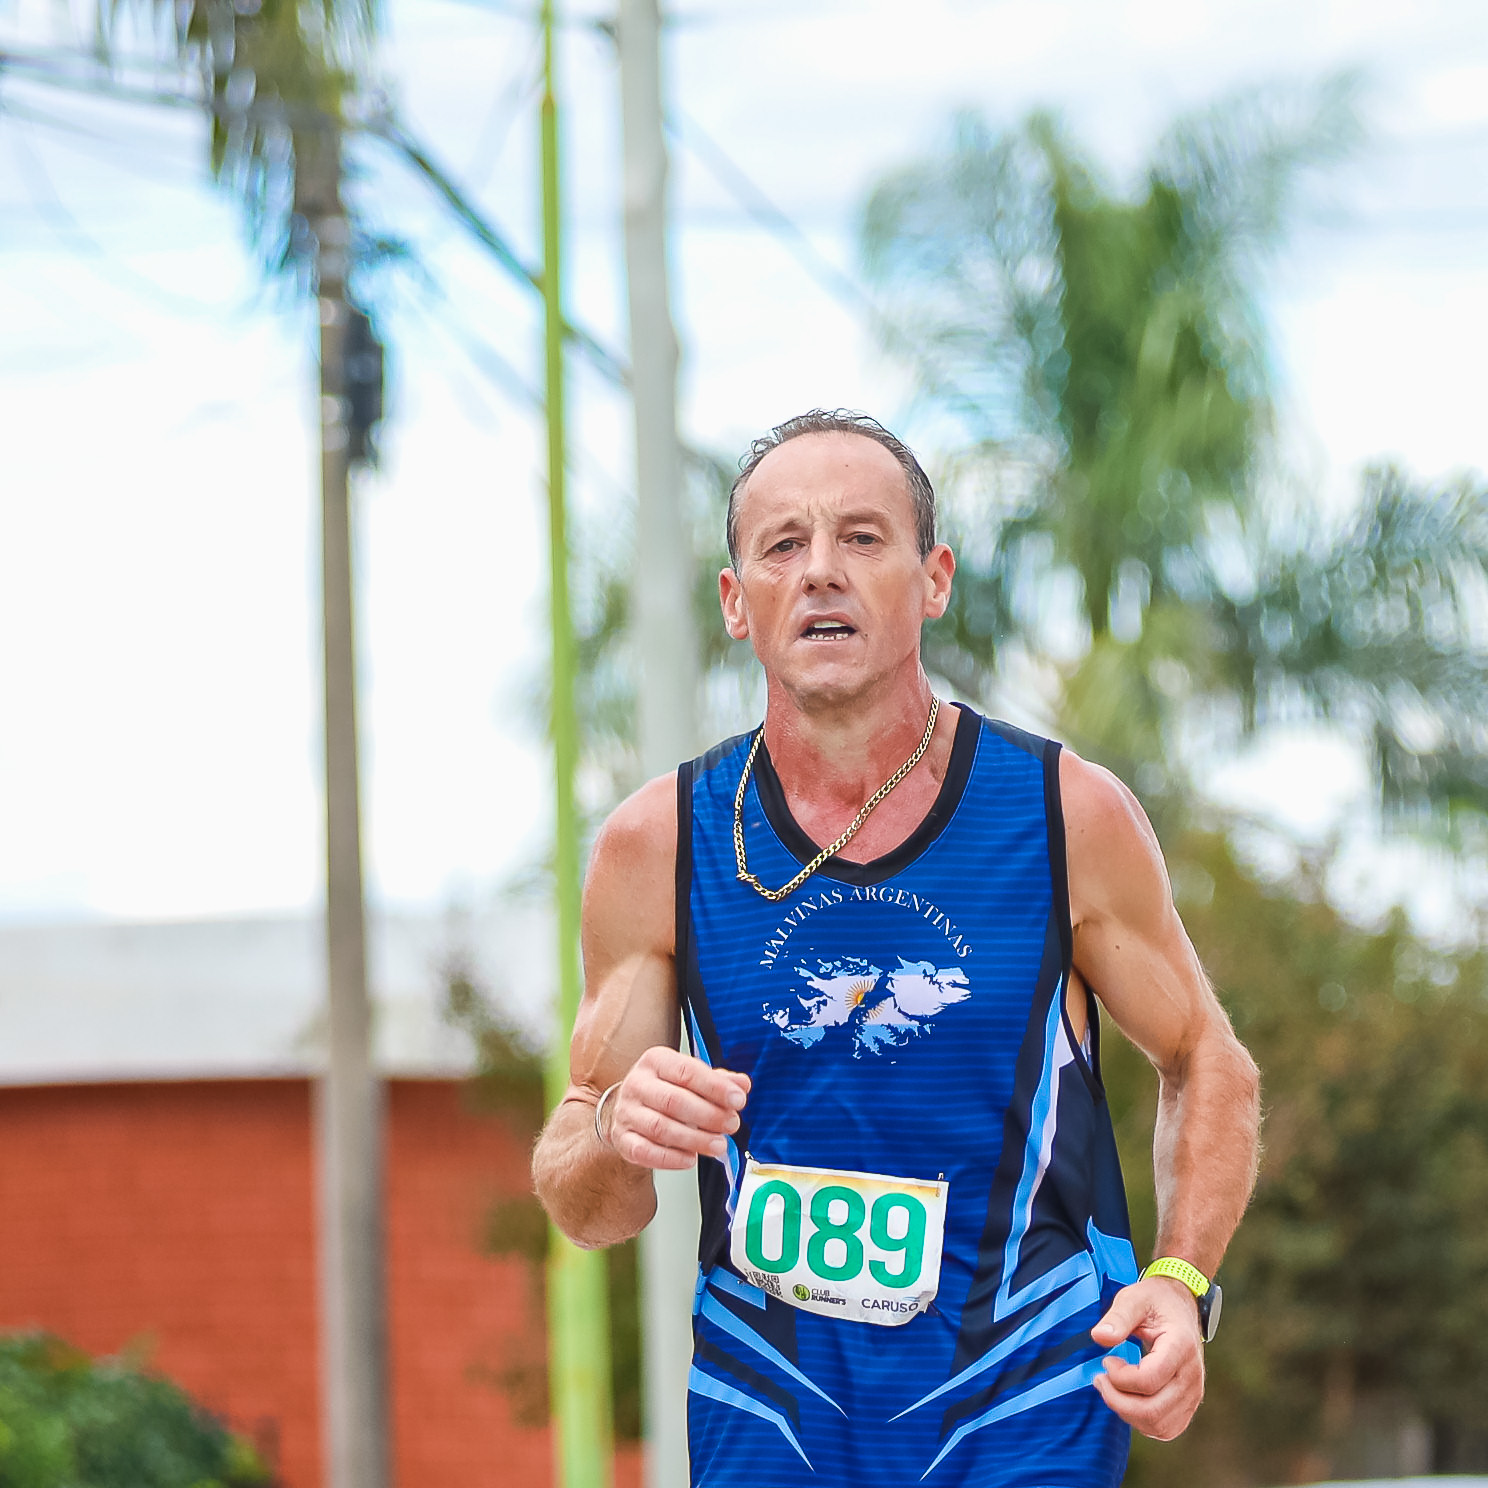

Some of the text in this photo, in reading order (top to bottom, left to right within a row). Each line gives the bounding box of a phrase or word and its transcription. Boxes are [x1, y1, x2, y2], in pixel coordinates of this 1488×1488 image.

[759, 886, 973, 970] MALVINAS ARGENTINAS
[745, 1179, 927, 1288] 089
[811, 1288, 830, 1297] CLUB
[861, 1298, 919, 1313] CARUSO
